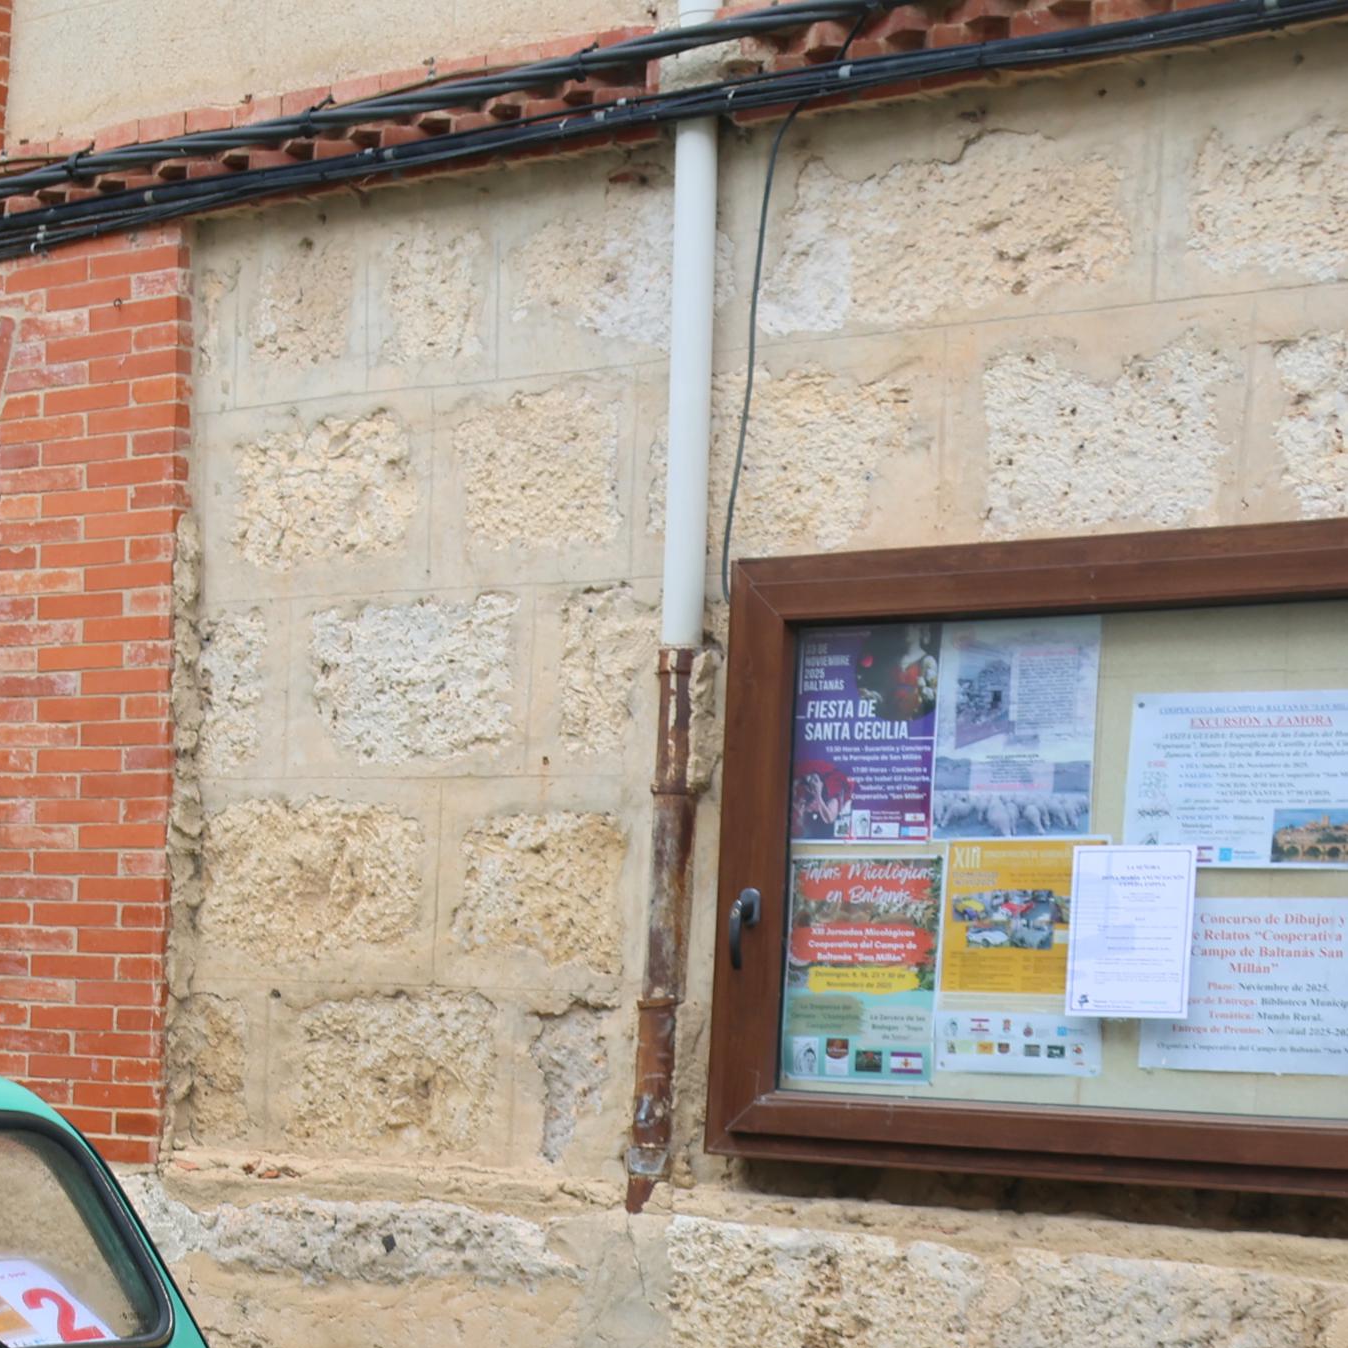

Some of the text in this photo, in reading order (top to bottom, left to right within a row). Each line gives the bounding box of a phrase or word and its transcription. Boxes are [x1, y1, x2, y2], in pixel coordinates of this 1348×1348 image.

[805, 655, 850, 667] NOVIEMBRE
[805, 668, 825, 679] 2025
[804, 678, 845, 691] BALTANÁS
[807, 700, 877, 718] FIESTA DE
[1190, 715, 1333, 729] EXCURSIÓN A ZAMORA
[805, 721, 909, 741] SANTA CECILIA
[849, 754, 879, 762] Parroquia
[851, 793, 888, 801] Cooperativa
[802, 860, 936, 885] Tapas Micológicas
[826, 884, 913, 905] en Baltanás
[1200, 911, 1345, 928] Concurso de Dibujos y
[826, 927, 863, 937] Jornadas
[864, 927, 916, 938] Micológicas
[1204, 929, 1251, 941] Relatos
[808, 939, 917, 951] Cooperativa del Campo de
[816, 951, 852, 961] Baltanás
[1240, 946, 1255, 957] de
[1259, 945, 1315, 959] Baltanás
[1318, 947, 1344, 959] San
[1238, 981, 1289, 992] Noviembre
[1291, 982, 1304, 992] de
[1305, 982, 1330, 993] 2025.
[1261, 996, 1307, 1007] Biblioteca
[1257, 1011, 1290, 1021] Mundo
[1293, 1011, 1324, 1022] Rural.
[22, 1287, 106, 1343] 2
